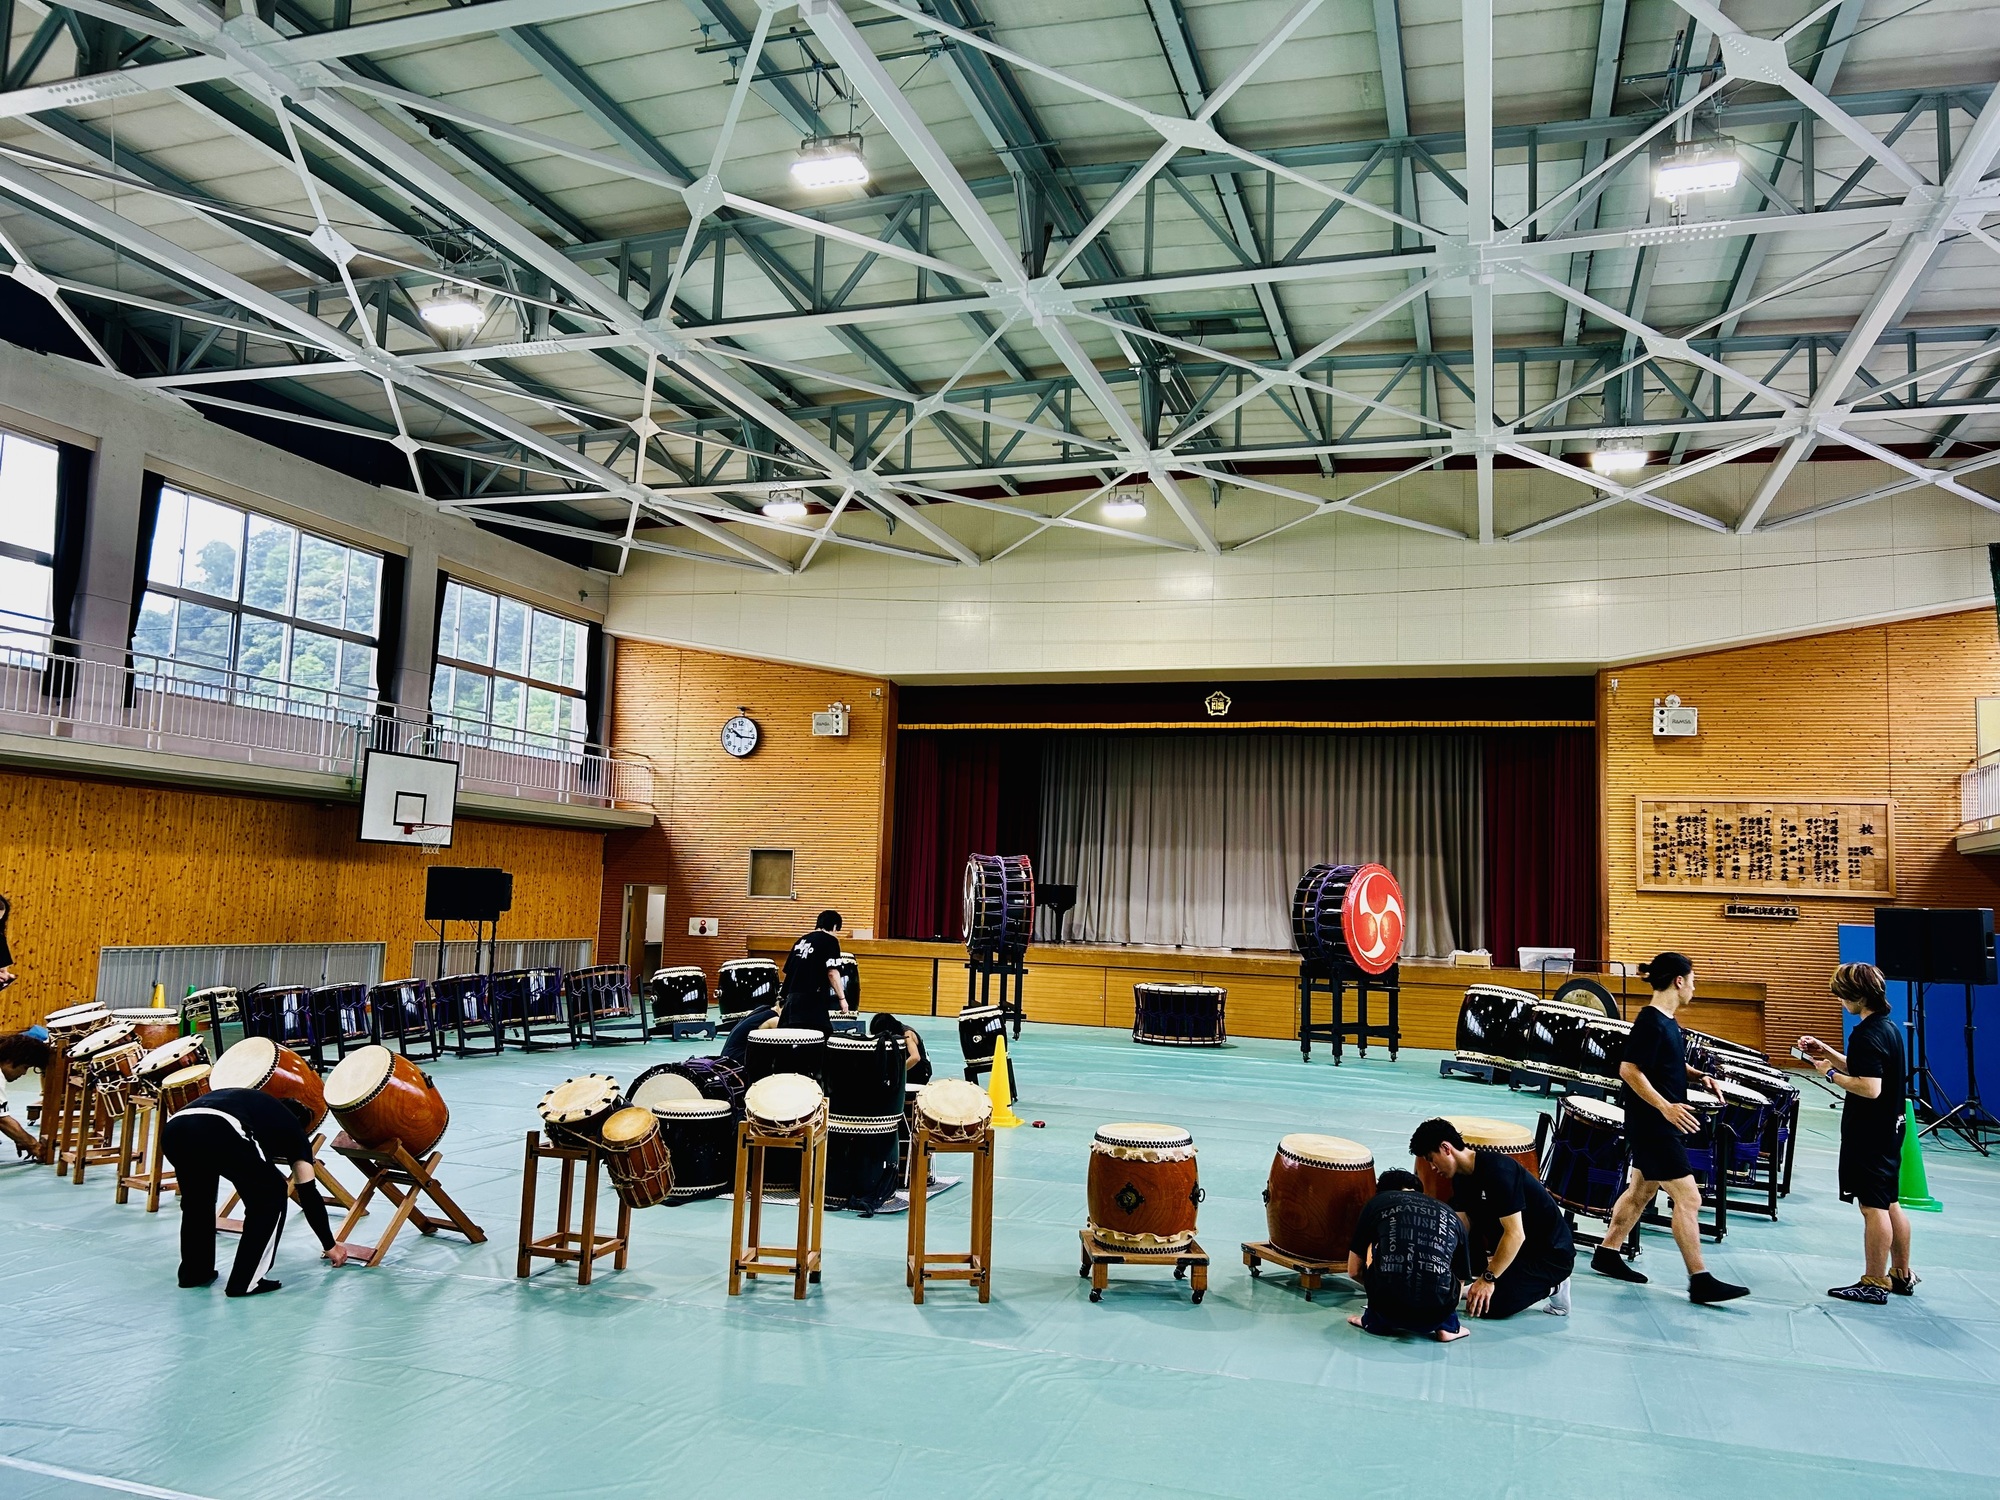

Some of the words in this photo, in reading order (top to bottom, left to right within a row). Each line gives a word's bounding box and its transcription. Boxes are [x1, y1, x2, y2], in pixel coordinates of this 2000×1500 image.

[1859, 823, 1875, 856] 校歌
[1381, 1204, 1437, 1219] KARATSU
[1438, 1206, 1449, 1237] TAISAI
[1388, 1216, 1398, 1253] HIMIKO
[1400, 1227, 1414, 1241] IKI
[1417, 1231, 1447, 1246] HAYATE
